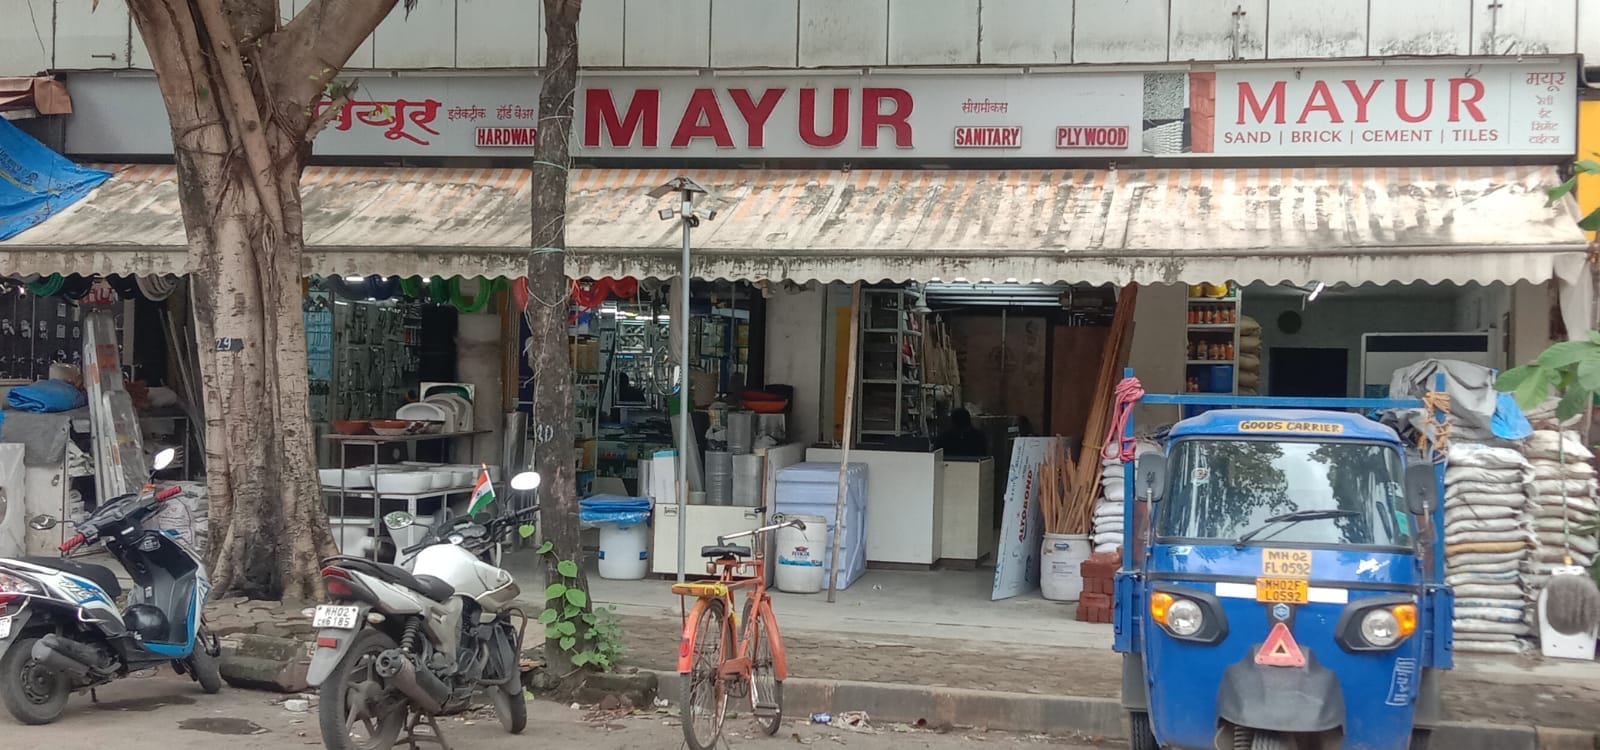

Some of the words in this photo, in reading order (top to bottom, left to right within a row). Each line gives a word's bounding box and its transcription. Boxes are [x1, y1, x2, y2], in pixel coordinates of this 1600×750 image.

[1526, 71, 1566, 92] मयूर
[1236, 78, 1487, 125] MAYUR
[583, 88, 914, 149] MAYUR
[477, 128, 537, 145] HARDWAR
[956, 128, 1020, 146] SANITARY
[1224, 131, 1272, 144] SAND
[1291, 130, 1342, 143] BRICK
[1361, 129, 1433, 142] CEMENT
[1453, 129, 1498, 142] TILES
[1240, 421, 1283, 430] GOODS
[1286, 422, 1341, 432] CARRIER
